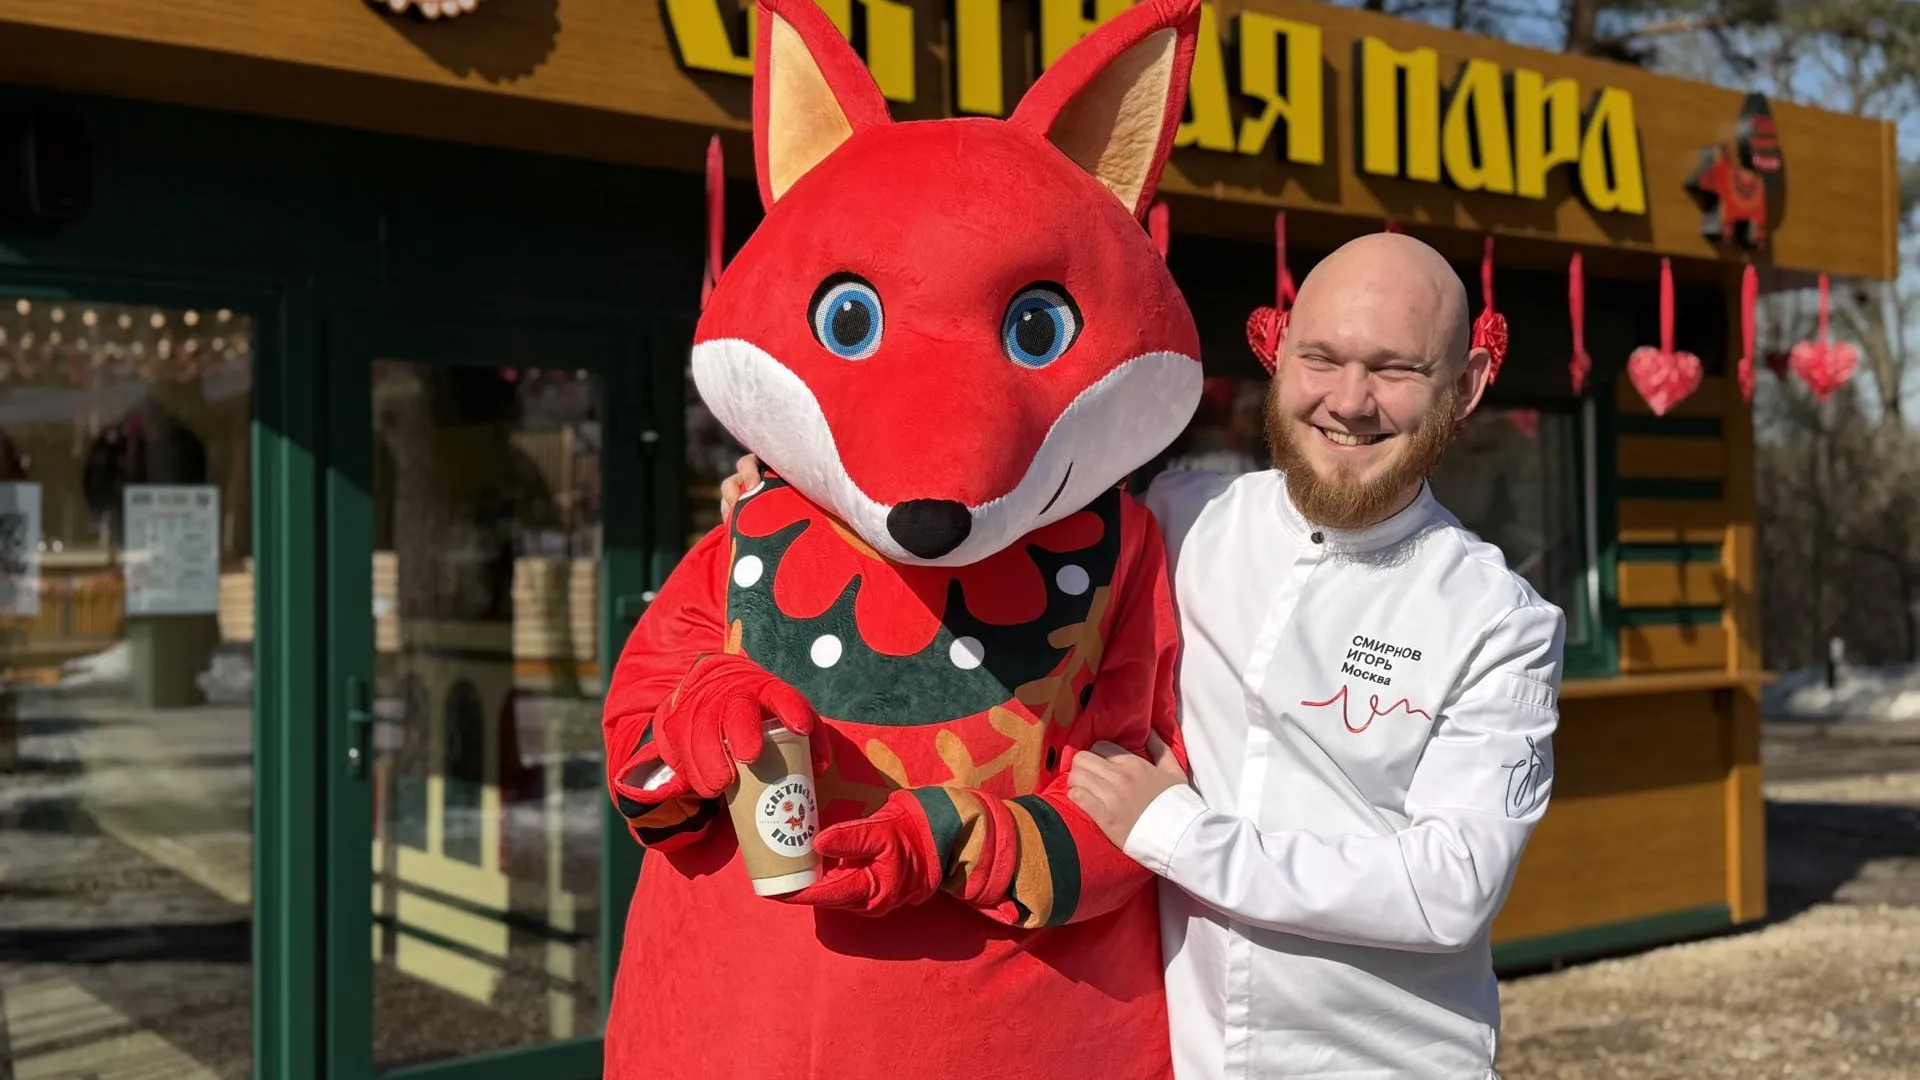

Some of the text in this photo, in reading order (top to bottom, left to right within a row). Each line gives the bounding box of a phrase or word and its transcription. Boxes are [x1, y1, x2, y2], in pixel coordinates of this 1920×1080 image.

[1360, 36, 1646, 215] ПАРА
[1346, 648, 1394, 671] ИГОРЬ
[1351, 635, 1423, 662] СМИРНОВ
[1340, 661, 1392, 687] Москва
